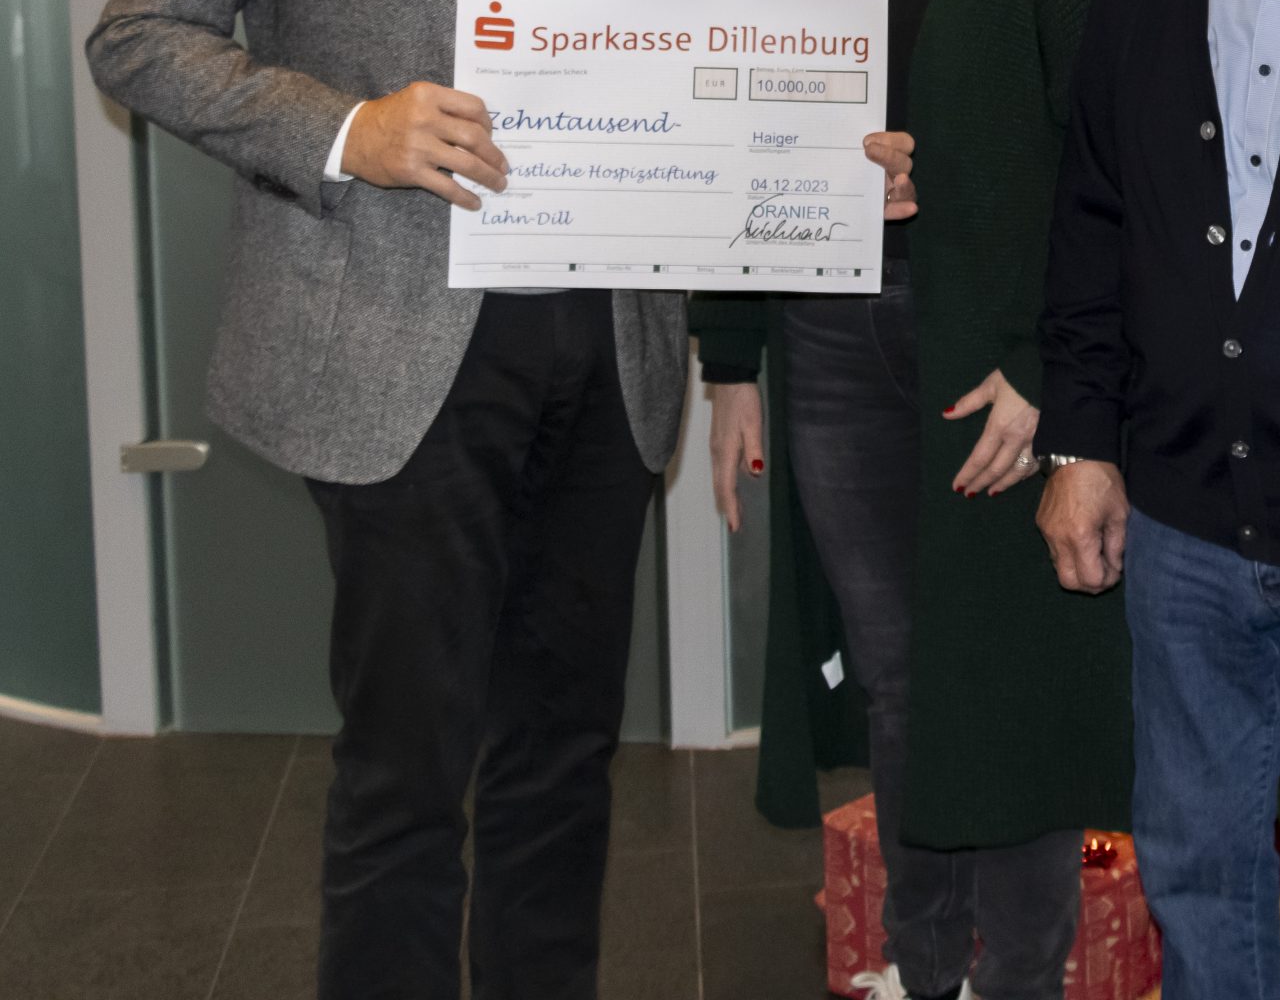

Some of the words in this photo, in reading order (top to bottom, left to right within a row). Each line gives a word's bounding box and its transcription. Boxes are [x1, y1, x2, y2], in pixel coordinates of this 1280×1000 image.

[530, 25, 692, 58] Sparkasse
[708, 26, 870, 63] Dillenburg
[563, 68, 588, 76] Scheck
[705, 80, 726, 88] EUR
[757, 79, 826, 95] 10.000,00
[752, 131, 800, 148] Haiger
[508, 163, 585, 179] ristliche
[588, 164, 720, 187] Hospizstiftung
[751, 178, 829, 193] 04.12.2023
[481, 209, 574, 227] Lahn-Dill
[752, 204, 830, 220] ORANIER
